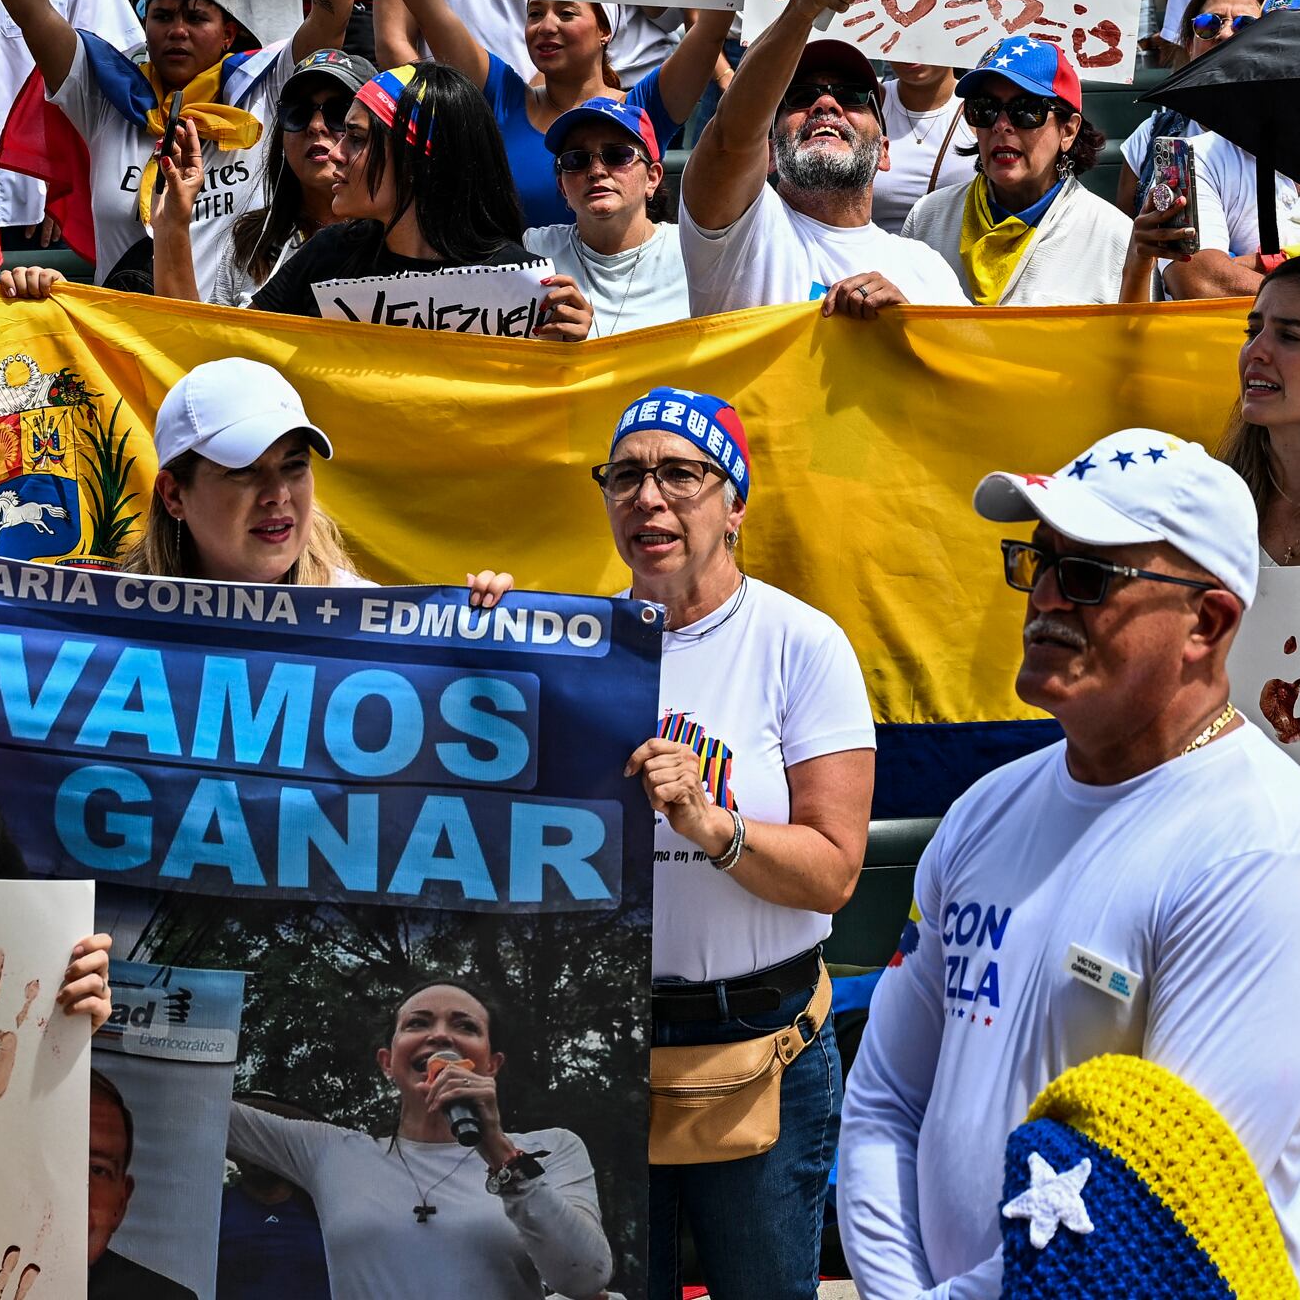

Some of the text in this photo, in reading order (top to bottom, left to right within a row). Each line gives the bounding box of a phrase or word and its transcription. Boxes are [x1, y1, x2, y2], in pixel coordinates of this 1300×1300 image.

[305, 52, 352, 69] VZLA
[619, 399, 747, 483] NEZUELA
[113, 578, 299, 626] CORINA
[359, 600, 603, 648] EDMUNDO
[54, 766, 612, 903] GANAR
[674, 851, 689, 864] en
[942, 902, 1012, 951] CON
[945, 955, 1000, 1008] ZLA
[111, 1001, 158, 1031] ad
[138, 1032, 226, 1054] Democrática
